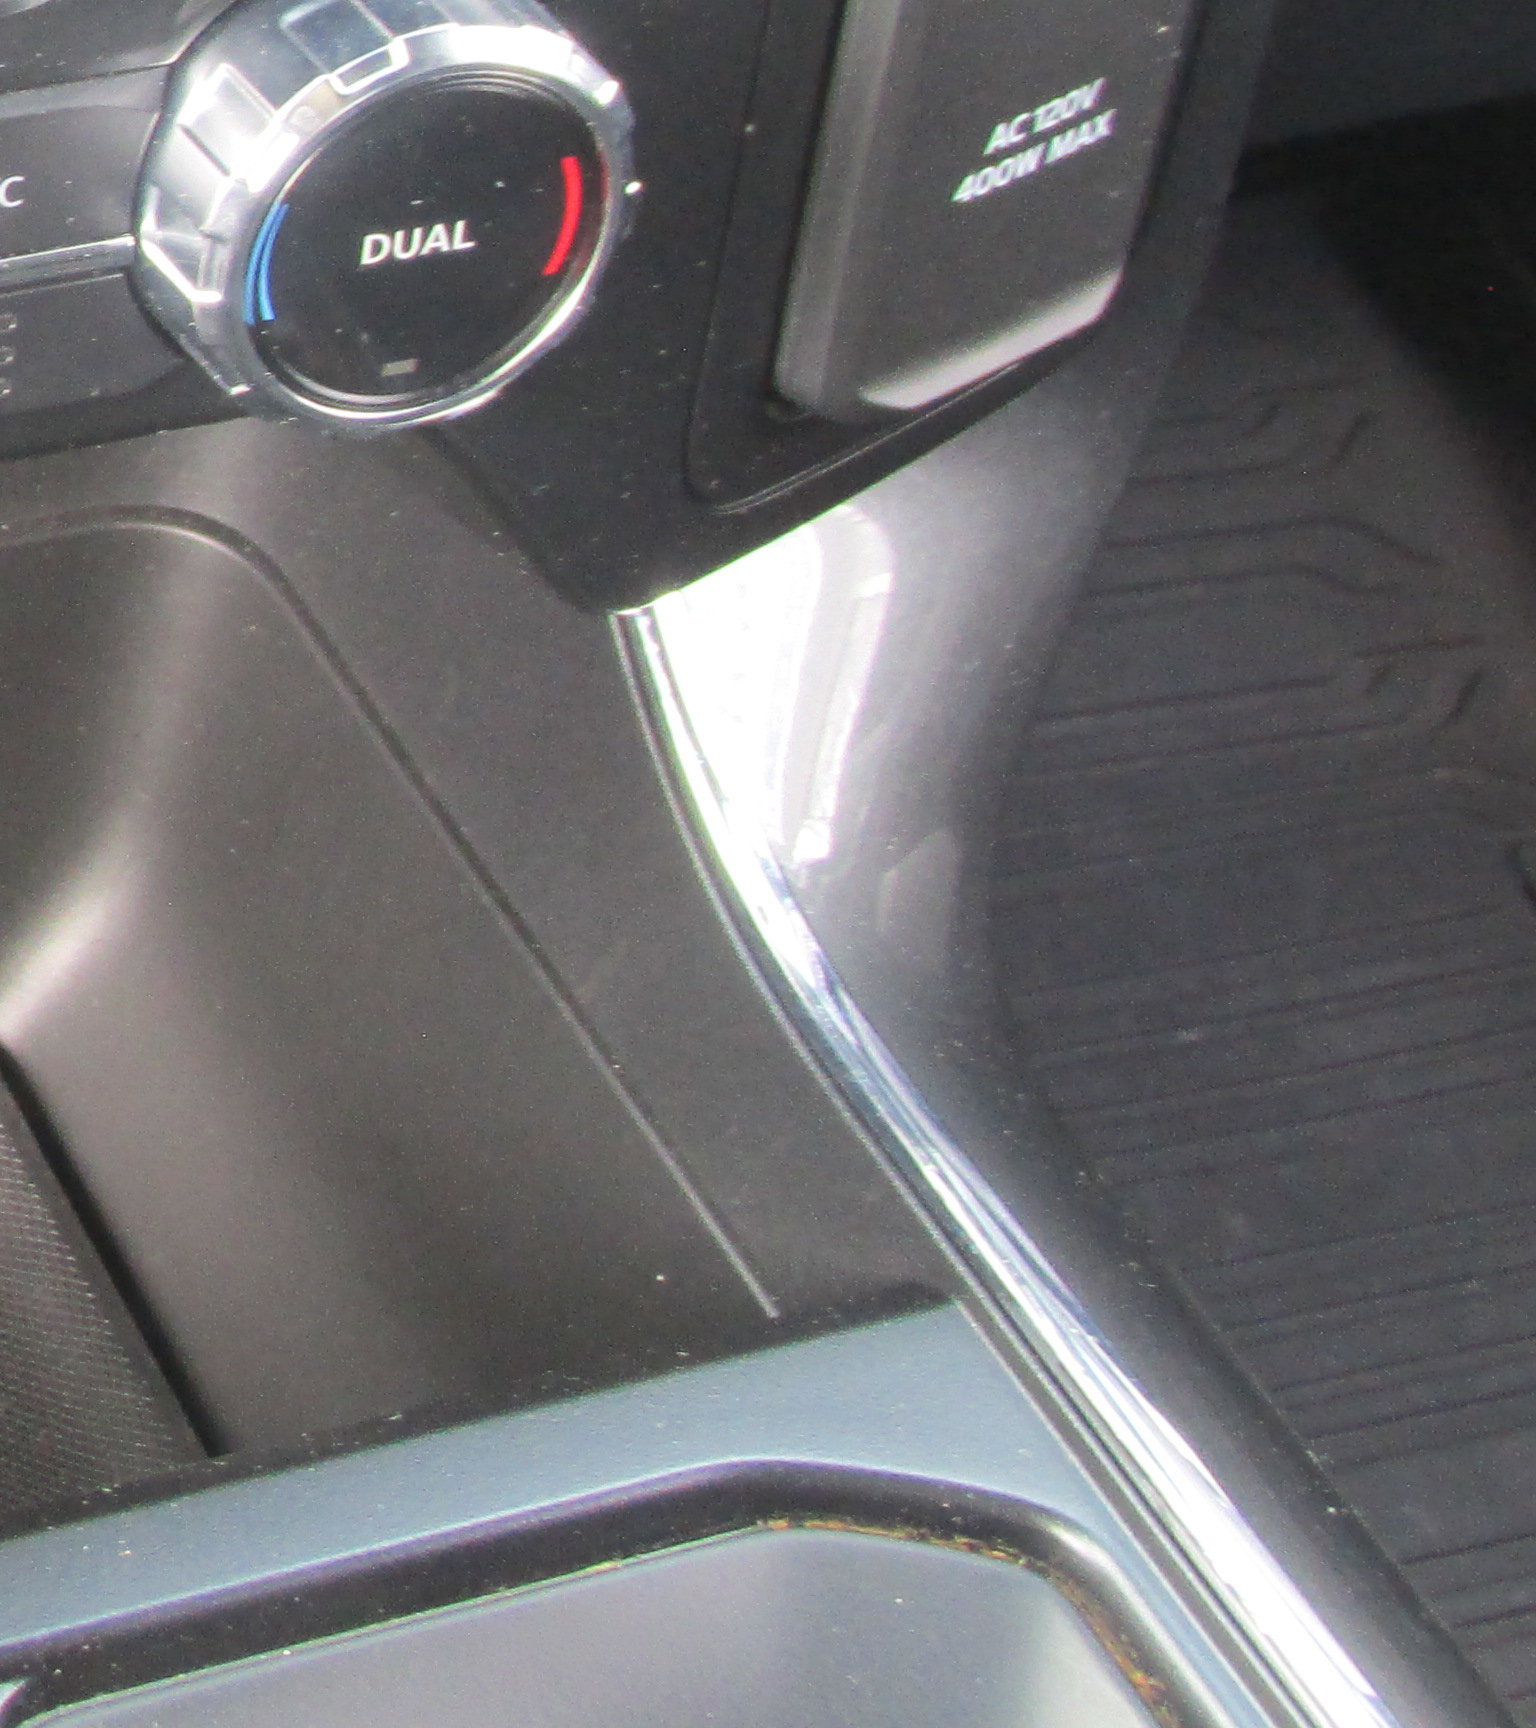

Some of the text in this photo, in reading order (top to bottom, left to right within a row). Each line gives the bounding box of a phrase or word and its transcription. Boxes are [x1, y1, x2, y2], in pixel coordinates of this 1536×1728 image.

[952, 108, 1118, 202] 400W MAX
[359, 219, 476, 267] DUAL
